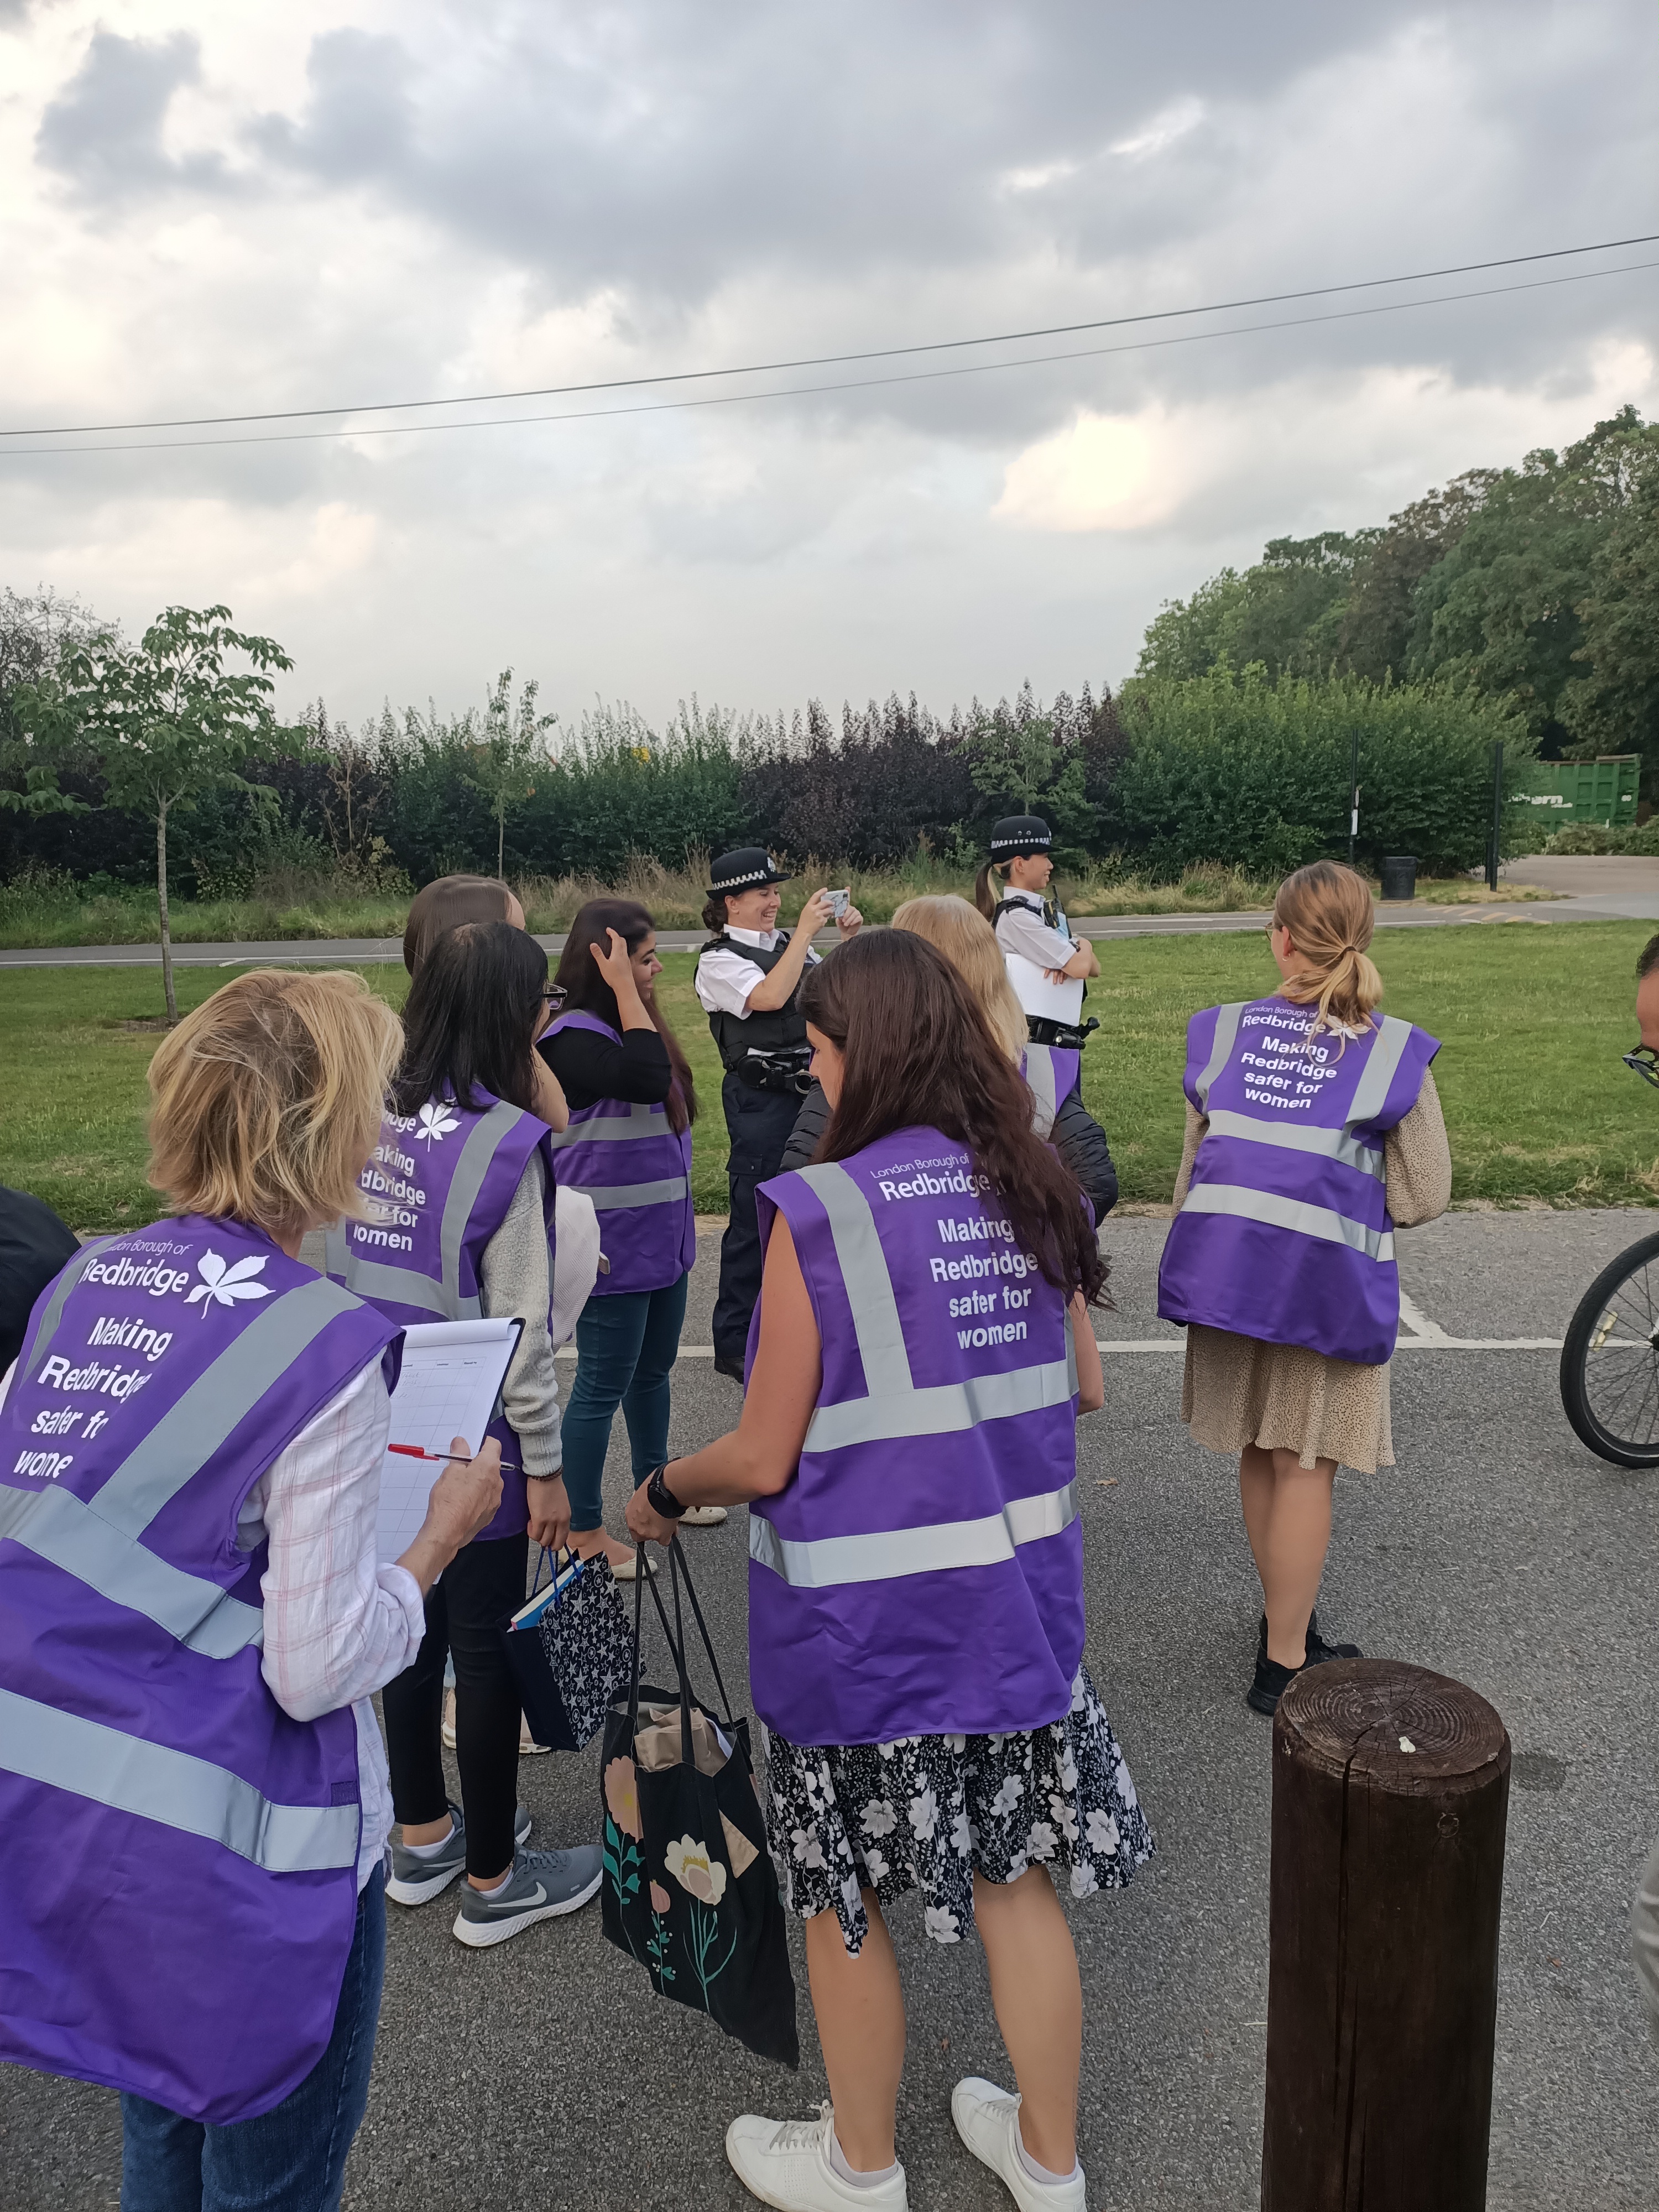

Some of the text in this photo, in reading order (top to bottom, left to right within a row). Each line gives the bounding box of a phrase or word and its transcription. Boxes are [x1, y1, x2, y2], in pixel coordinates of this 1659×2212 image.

[1242, 1015, 1326, 1035] Redbridge
[1245, 1006, 1273, 1014] London
[1274, 1007, 1307, 1018] Borough
[1261, 1036, 1329, 1063] Making
[1241, 1052, 1337, 1080] Redbridge
[1244, 1072, 1323, 1094] safer for
[1245, 1088, 1311, 1109] women
[372, 1144, 415, 1177] aking
[870, 1152, 970, 1179] London Borough of
[361, 1169, 426, 1206] dbridge
[878, 1169, 990, 1201] Redbridge
[392, 1206, 418, 1228] for
[937, 1216, 1015, 1243] Making
[112, 1239, 194, 1256] don Borough of
[78, 1257, 189, 1296] Redbridge
[929, 1250, 1039, 1282] Redbridge
[949, 1285, 1031, 1318] safer for
[87, 1317, 173, 1361] Making
[957, 1321, 1027, 1349] women
[37, 1355, 153, 1404] Redbridge
[31, 1405, 109, 1439] safer fo
[13, 1450, 74, 1479] wome
